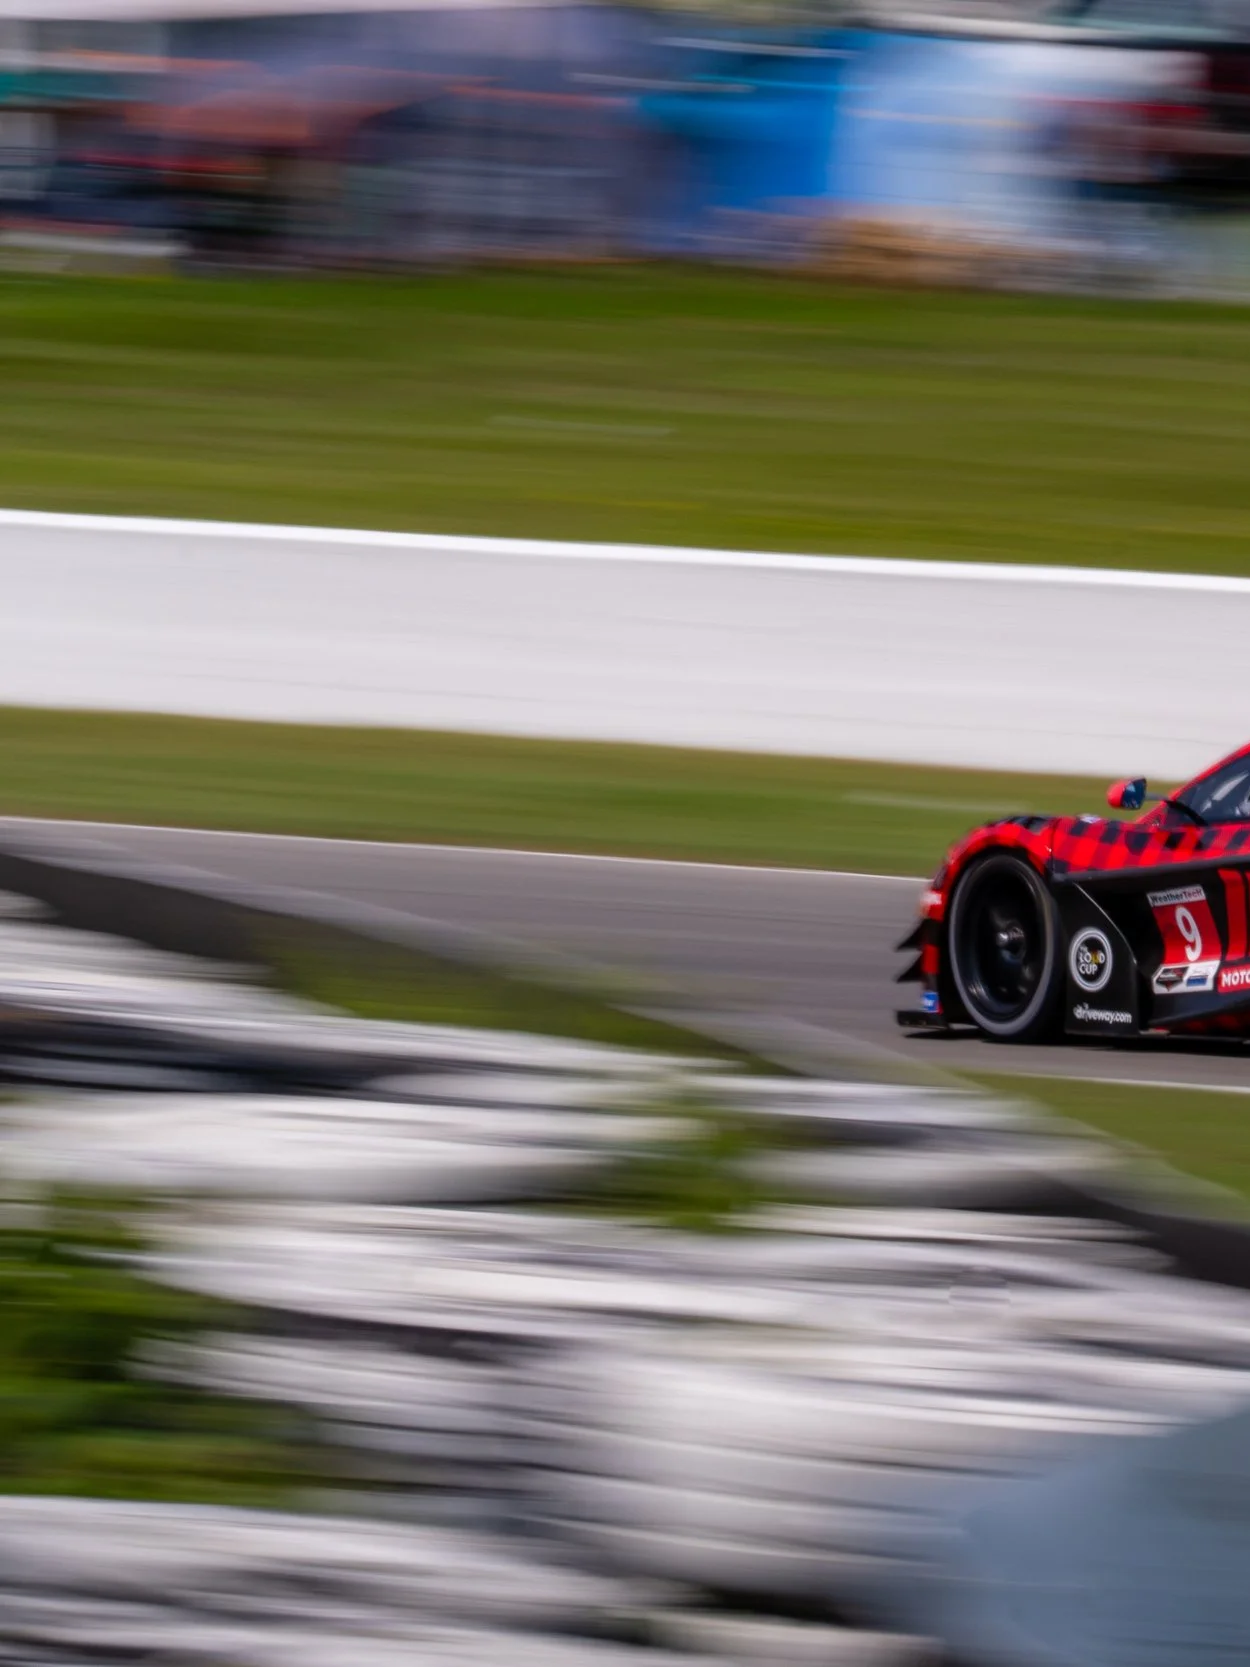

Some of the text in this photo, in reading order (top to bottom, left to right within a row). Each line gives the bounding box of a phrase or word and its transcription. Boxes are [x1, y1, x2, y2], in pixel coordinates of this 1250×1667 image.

[1175, 906, 1202, 961] 9
[1080, 963, 1098, 975] CUP
[1073, 1003, 1132, 1024] driveway.com
